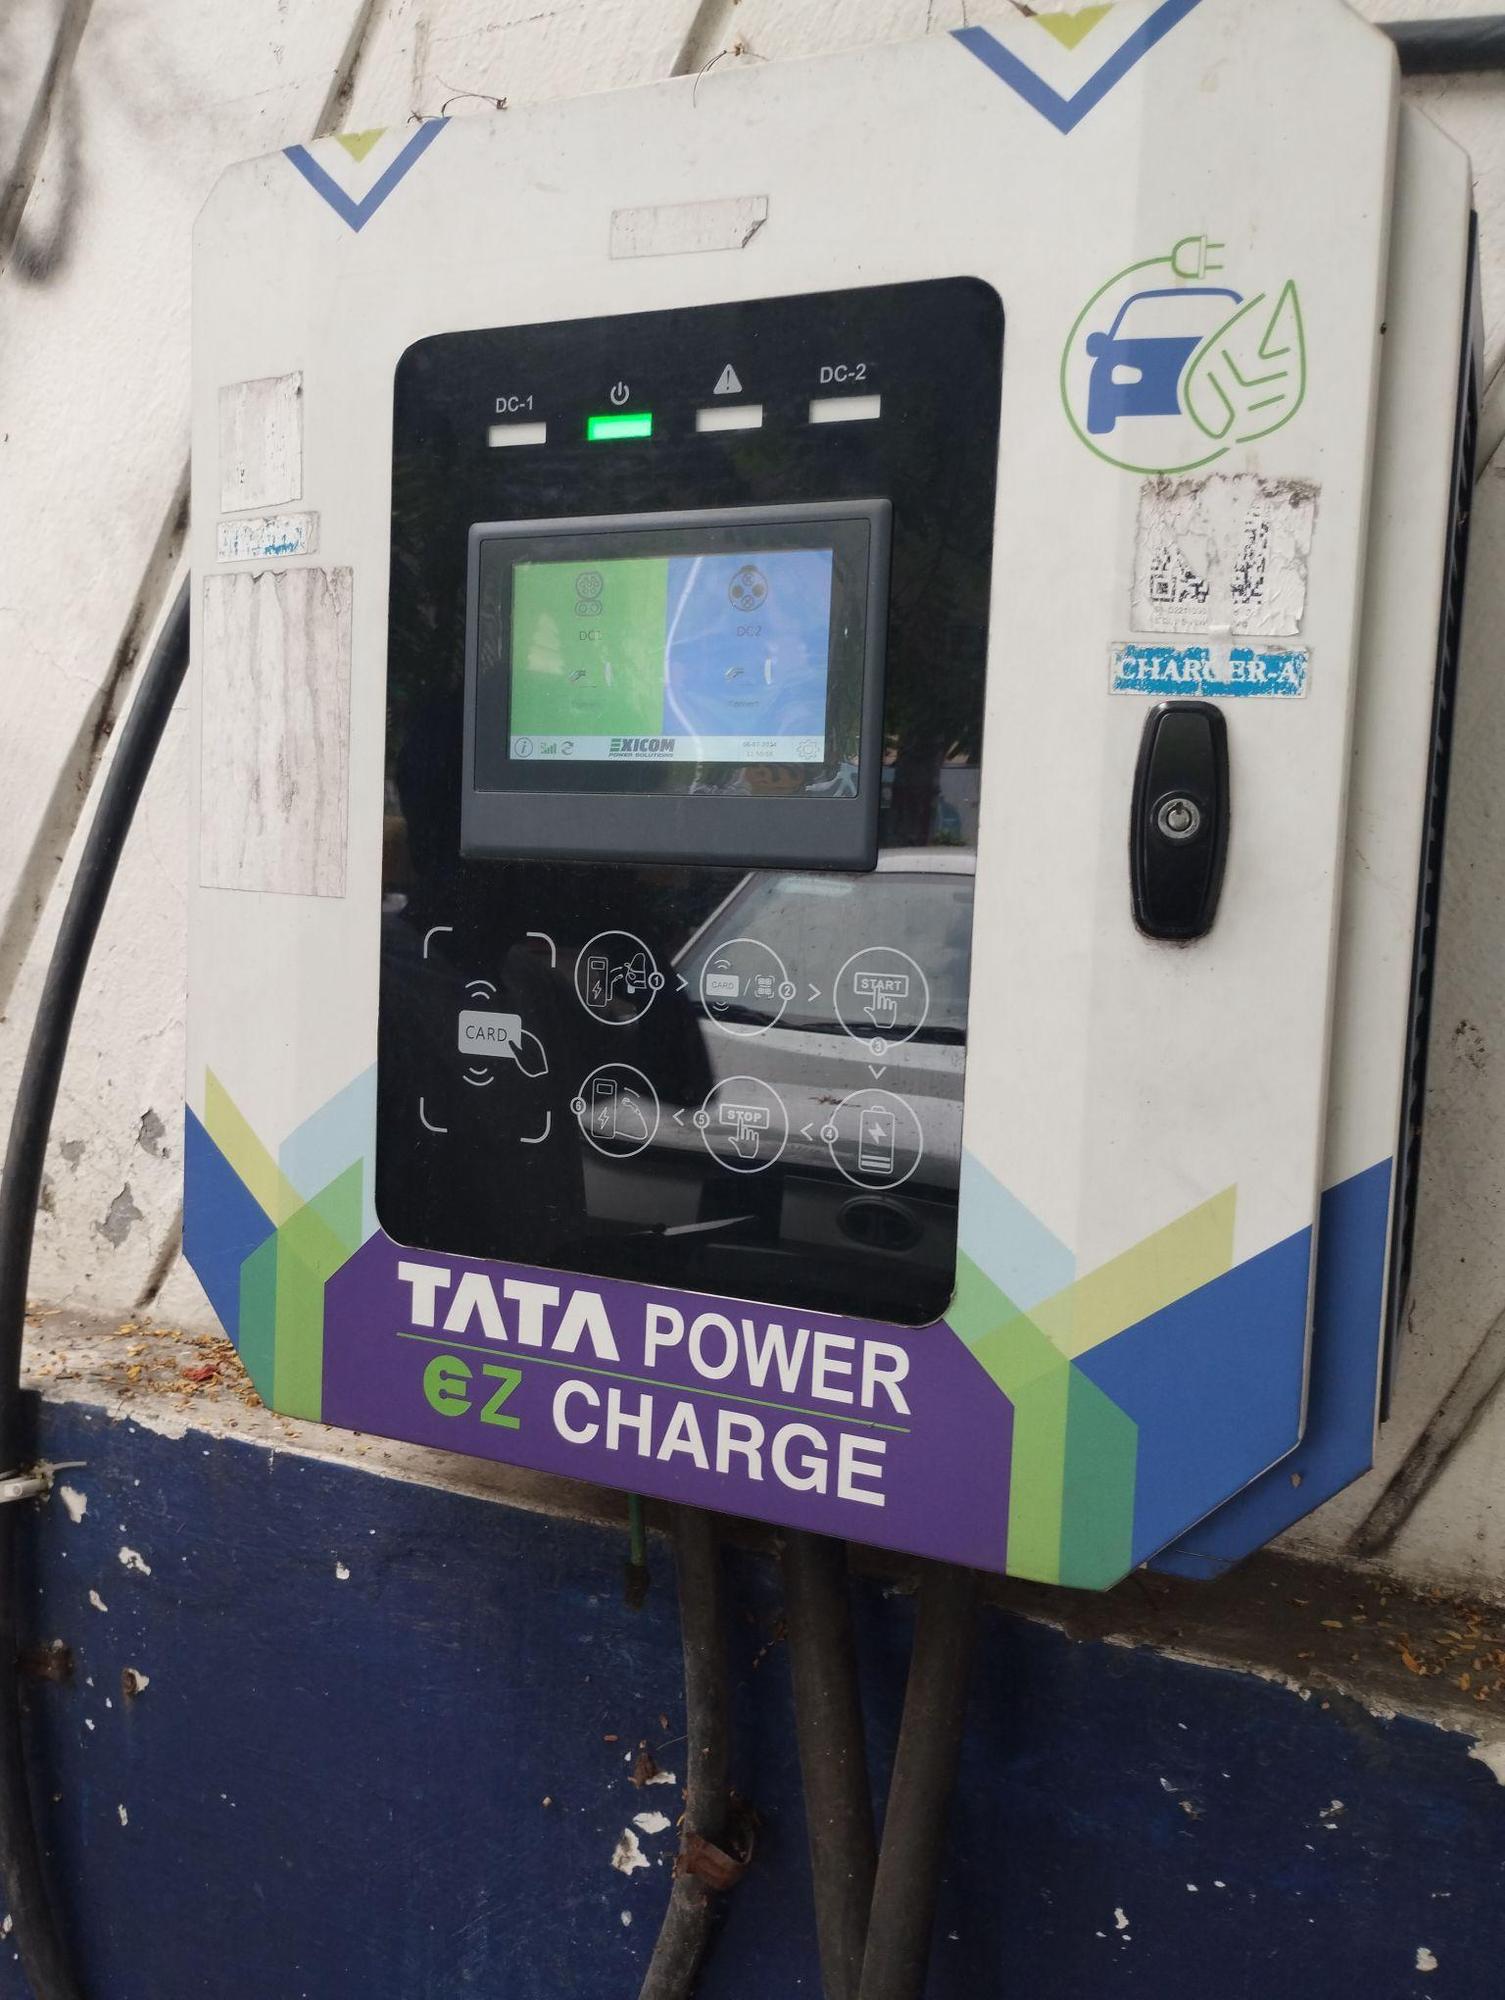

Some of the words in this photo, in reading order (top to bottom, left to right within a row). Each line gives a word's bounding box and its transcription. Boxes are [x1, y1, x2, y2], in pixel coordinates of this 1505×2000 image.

[819, 362, 868, 385] DC-2
[495, 395, 534, 414] DC-1
[736, 625, 762, 638] DC2
[609, 738, 676, 753] EXICOM
[710, 980, 735, 992] CARD
[860, 977, 903, 992] START
[465, 1025, 508, 1042] CARD
[727, 1109, 763, 1123] STOP
[397, 1261, 621, 1362] TATA
[644, 1302, 912, 1415] POWER
[552, 1379, 888, 1507] CHARGE
